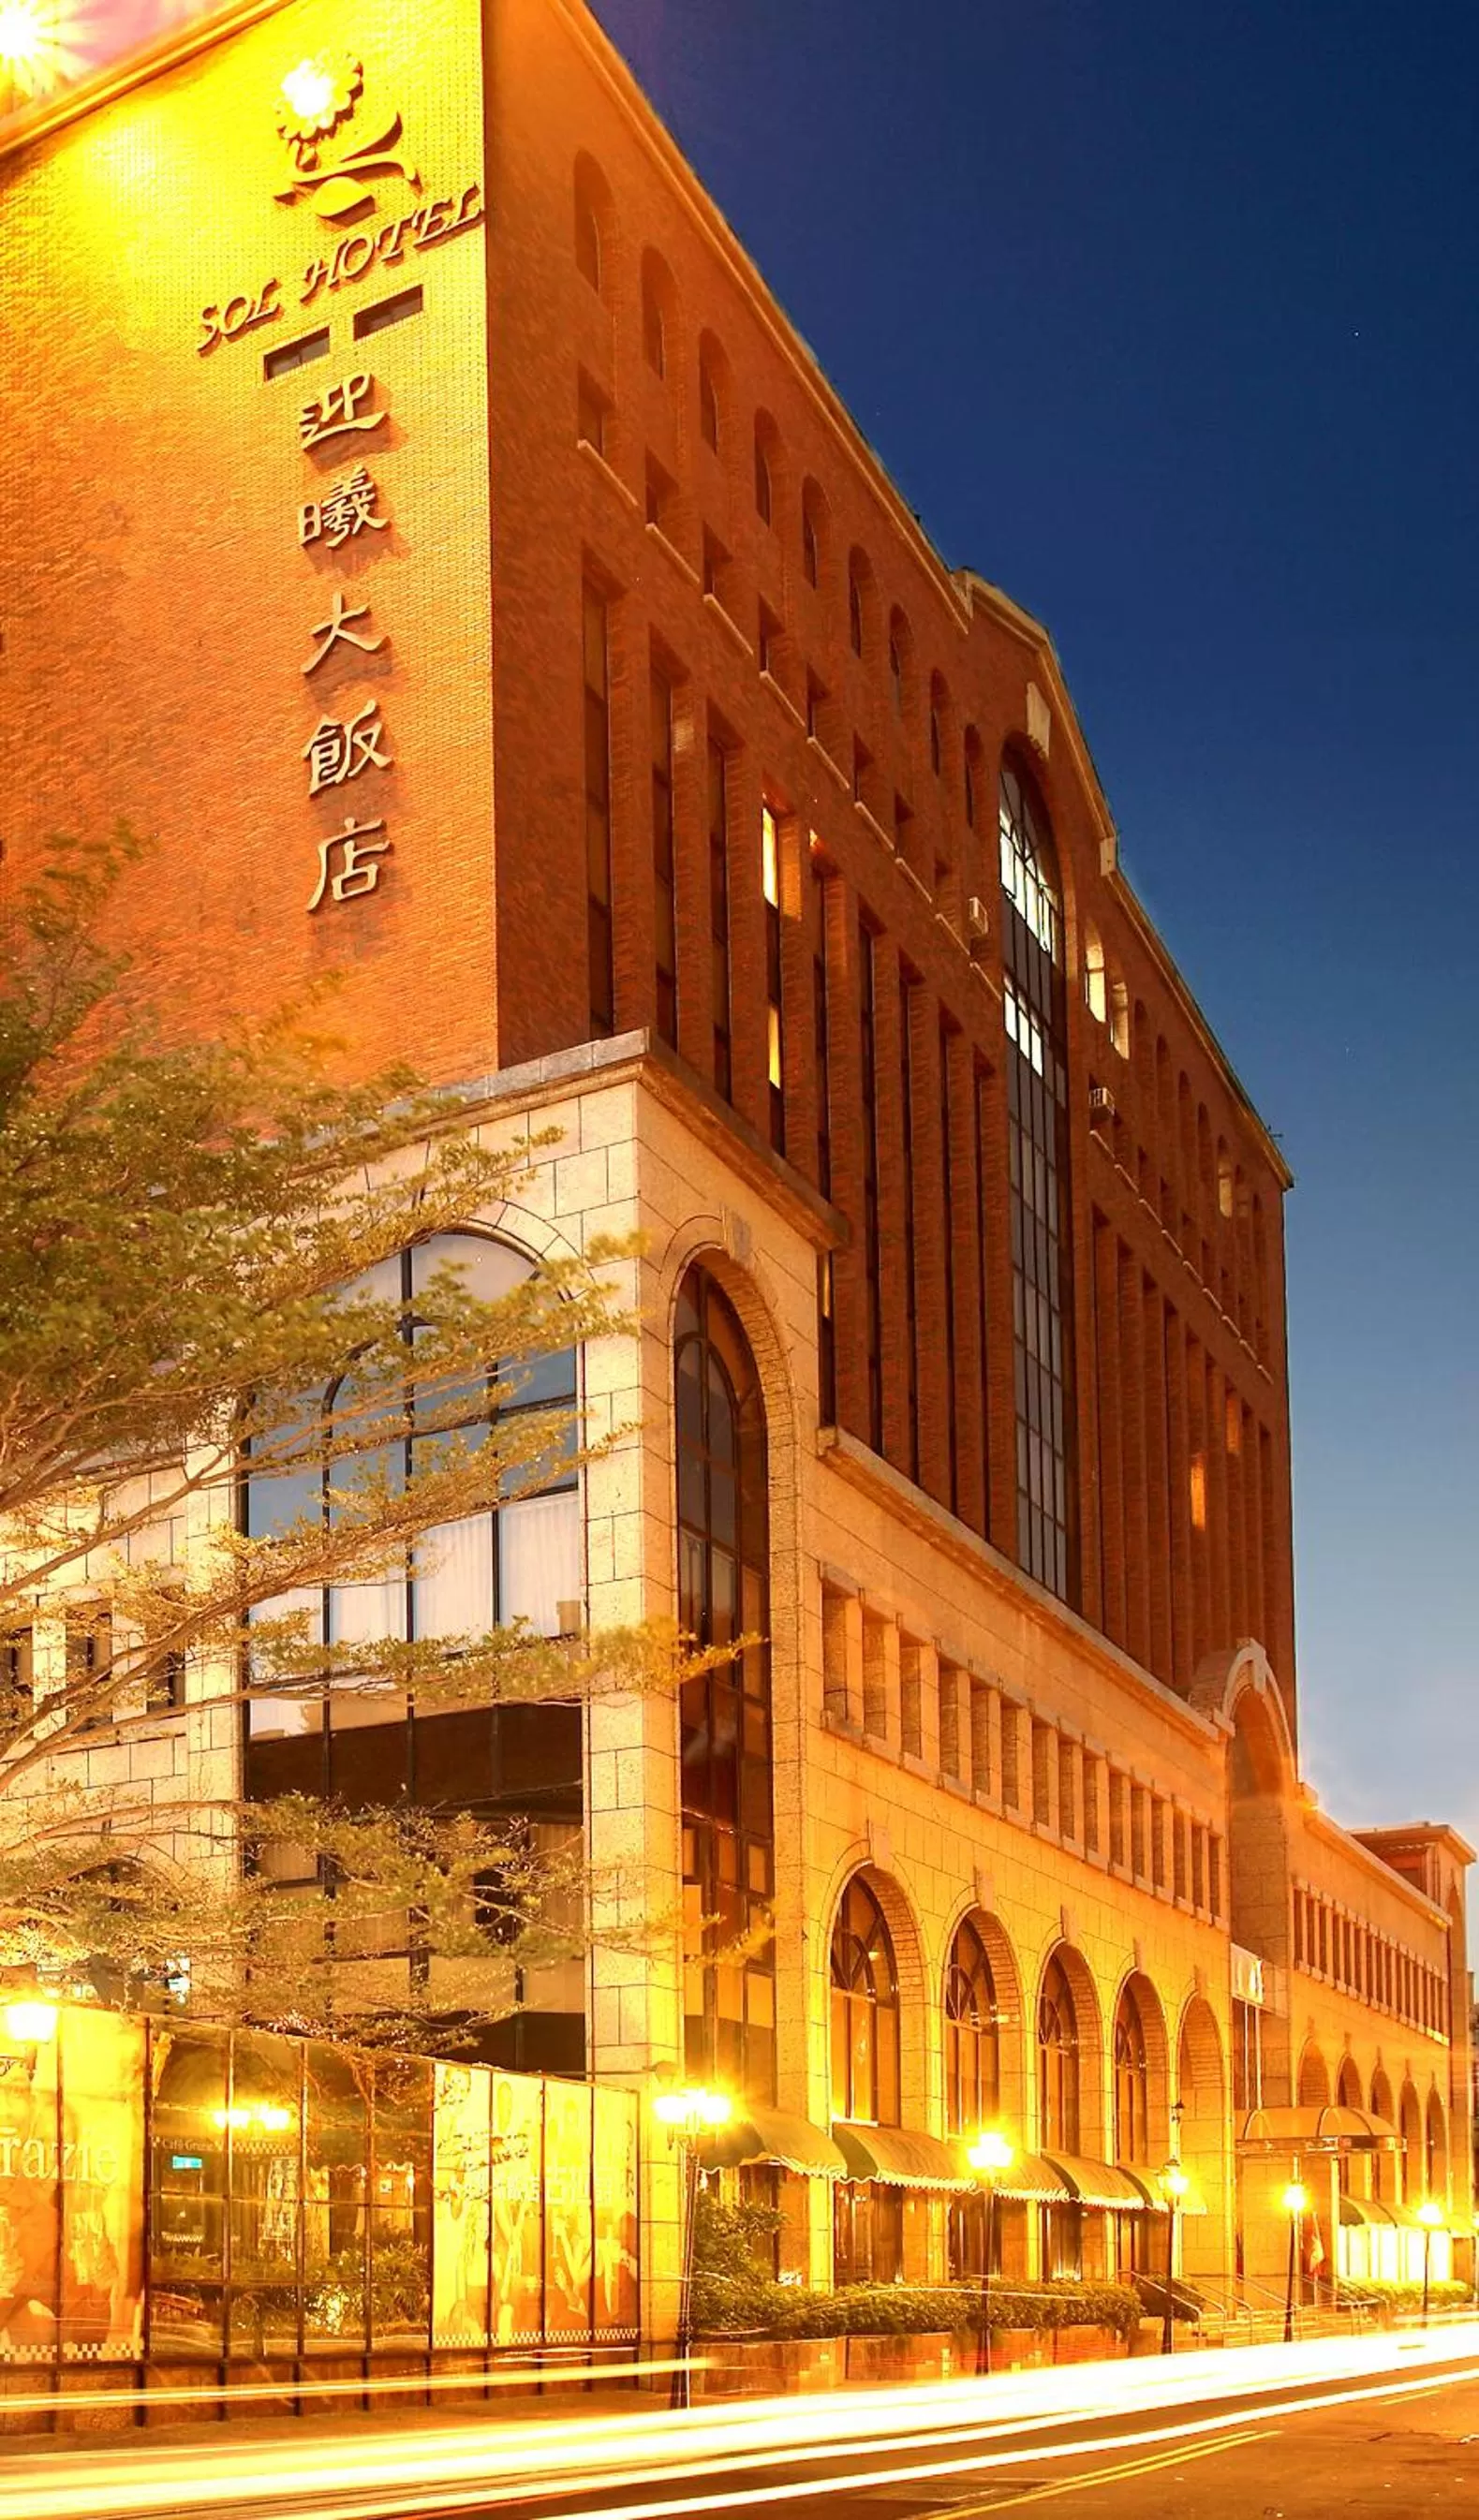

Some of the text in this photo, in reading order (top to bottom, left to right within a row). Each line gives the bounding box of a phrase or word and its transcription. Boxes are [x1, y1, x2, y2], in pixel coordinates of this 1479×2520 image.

[198, 184, 483, 351] SOL HOTEL
[300, 370, 394, 911] 迎曦大飯店
